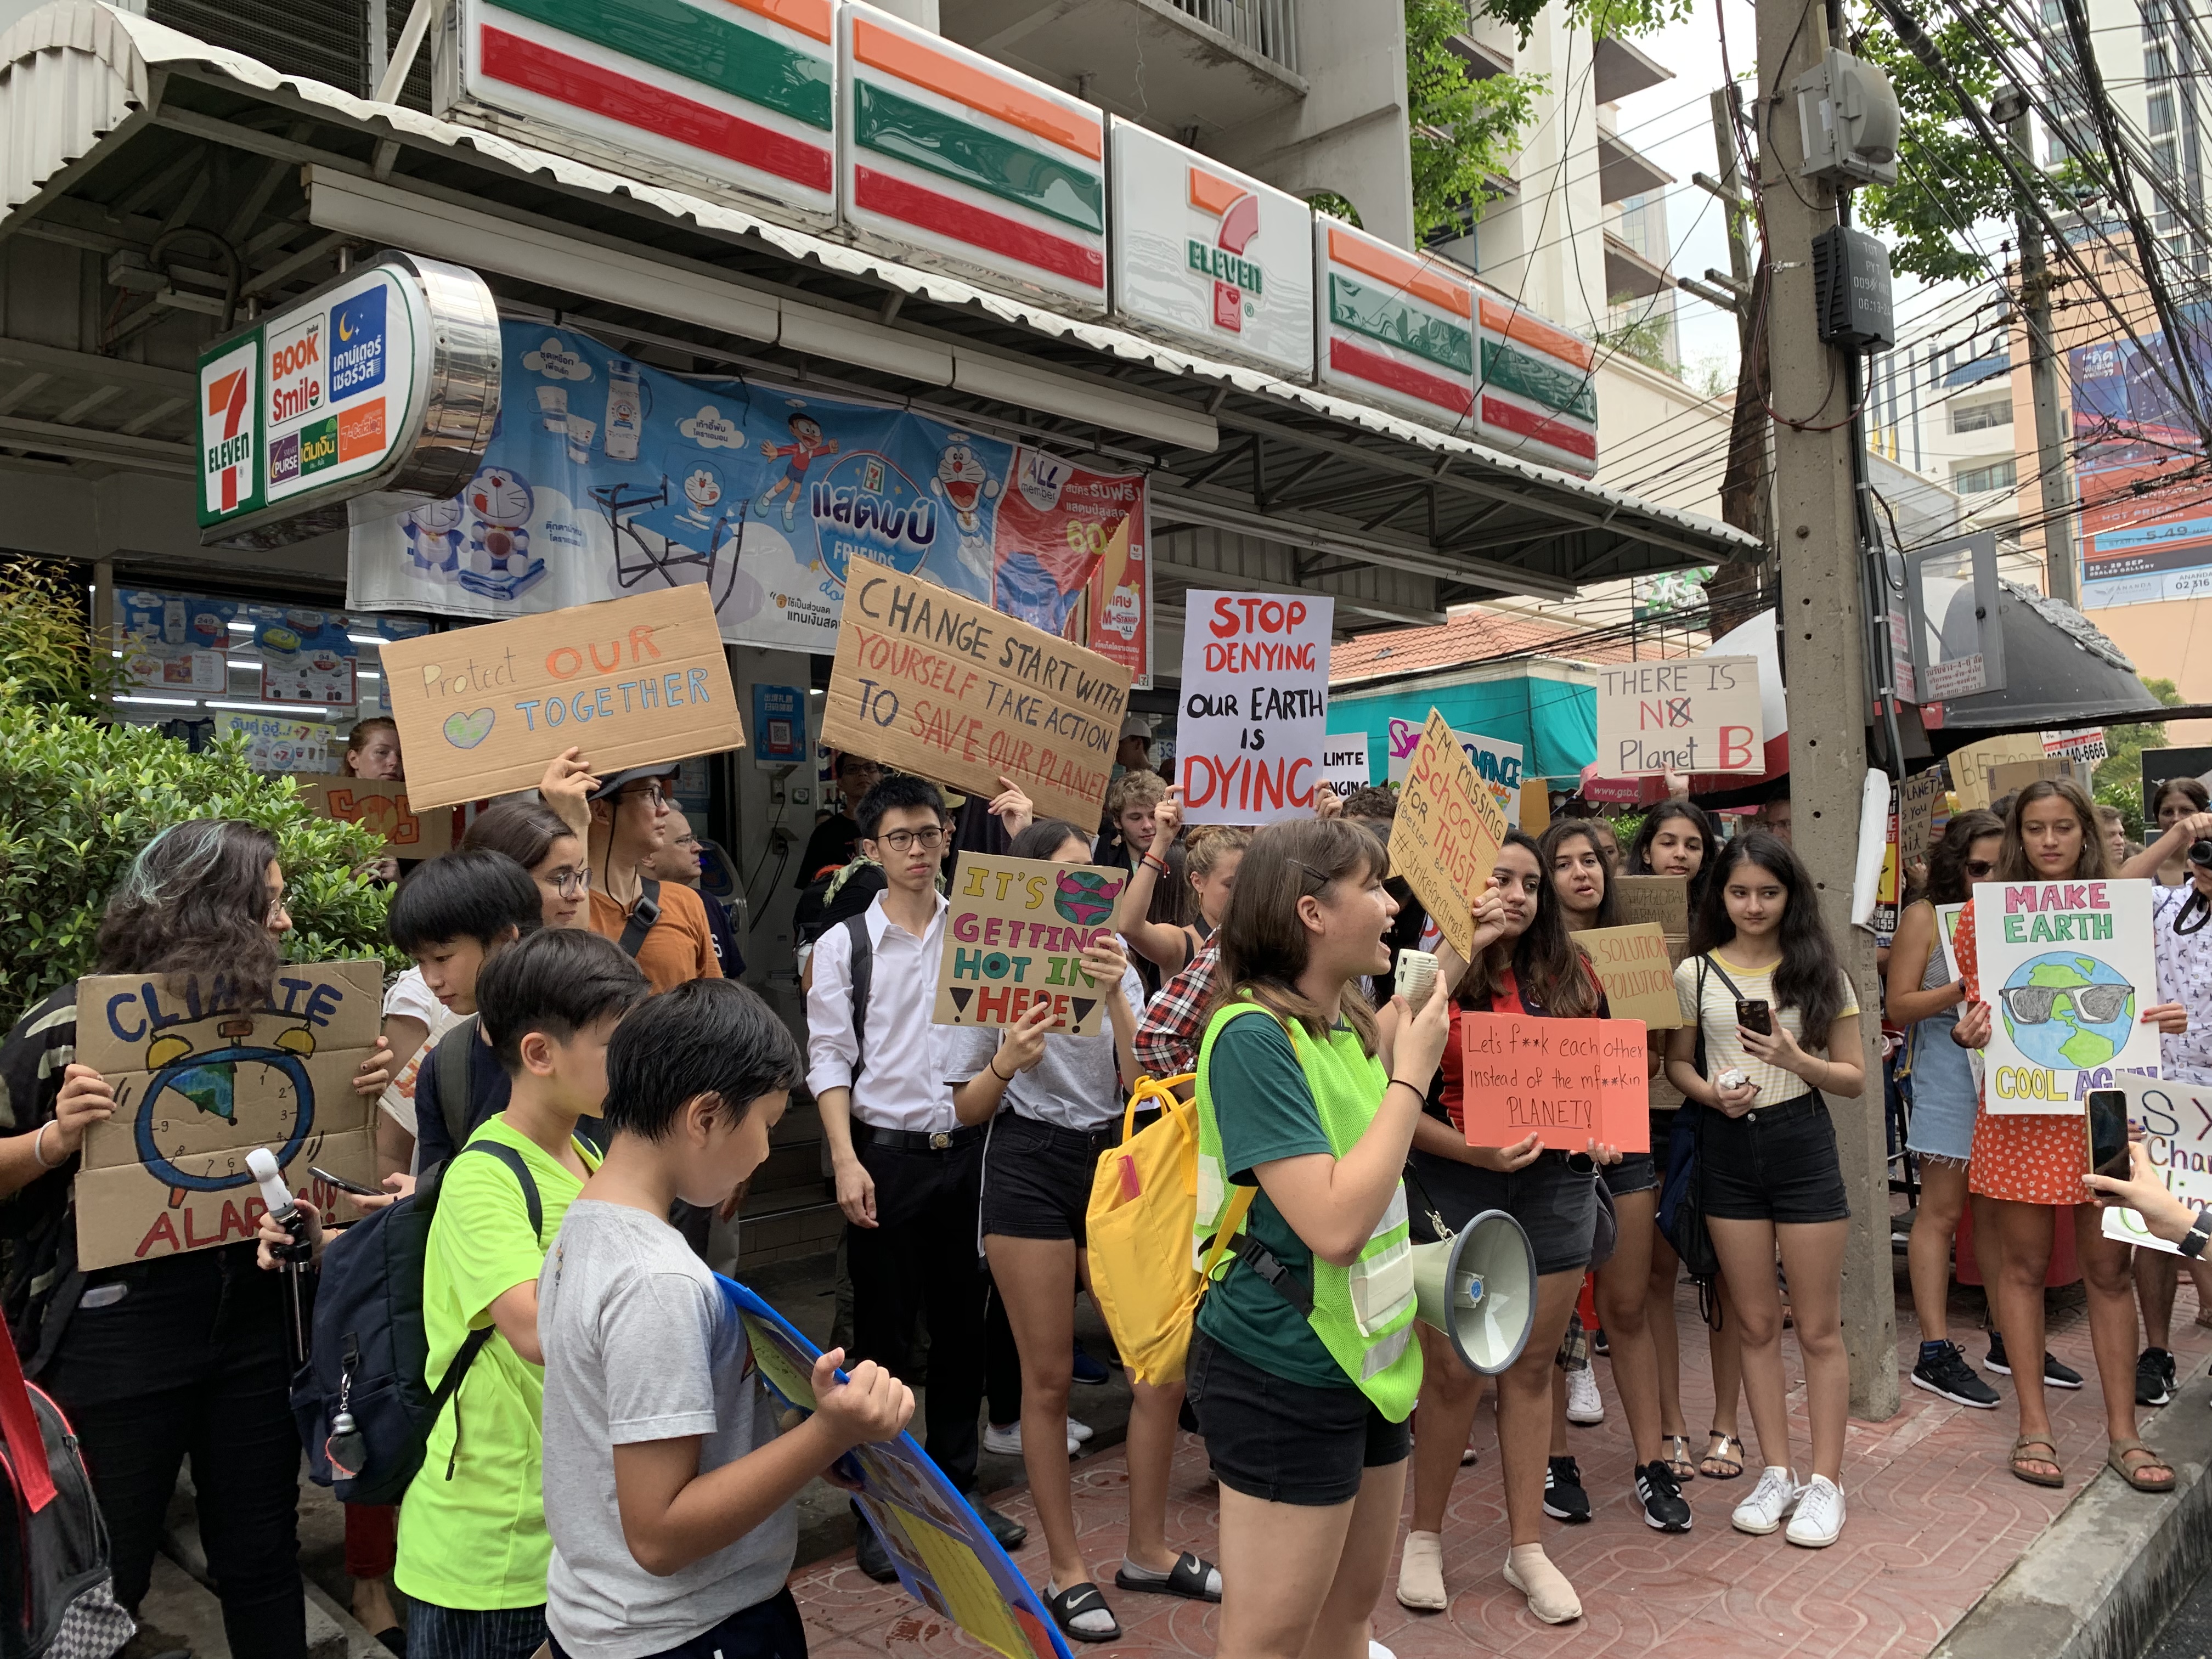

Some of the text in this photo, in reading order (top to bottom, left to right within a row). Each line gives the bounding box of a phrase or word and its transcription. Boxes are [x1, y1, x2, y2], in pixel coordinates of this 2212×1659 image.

[1863, 242, 1877, 256] TOT
[1866, 261, 1880, 275] PYT
[273, 332, 319, 381] BOOK
[273, 376, 319, 422] Smile
[275, 454, 298, 475] PURSE
[1023, 457, 1058, 489] ALL
[1021, 483, 1057, 501] member
[812, 483, 936, 545] แสตมป์
[1066, 520, 1108, 555] 60
[2176, 582, 2190, 590] 02
[1209, 597, 1307, 639] STOP
[422, 624, 661, 698] Protect OUR
[860, 578, 994, 661] CHANGE
[998, 637, 1077, 692] START
[1076, 671, 1125, 715] WITH
[1203, 641, 1316, 674] DENYING
[854, 626, 1113, 755] YOURSELF TAKE ACTION
[1600, 664, 1736, 697] THERE IS
[515, 668, 710, 731] TOGETHER
[1186, 687, 1324, 721] OUR EARTH
[858, 678, 1108, 805] TO SAVE OUR PLANET
[1240, 728, 1265, 751] IS
[1620, 725, 1754, 771] Planet B
[1324, 752, 1364, 766] LIMTE
[1426, 712, 1504, 841] I'M MISSING
[1183, 754, 1315, 812] DYING
[1594, 785, 1639, 798] www.gsb.c
[1906, 780, 1937, 802] LANET
[1405, 774, 1476, 896] FOR THIS!
[963, 866, 1047, 910] IT'S
[2005, 882, 2111, 913] MAKE
[953, 912, 1112, 953] GETTING
[2003, 913, 2113, 943] EARTH
[1599, 935, 1669, 964] SOLUTION
[953, 947, 1099, 989] HOT IN
[1468, 1024, 1502, 1054] Let's
[1559, 1036, 1599, 1058] each
[1603, 1037, 1644, 1059] other
[1470, 1064, 1517, 1090] instead
[1526, 1067, 1543, 1090] of
[1551, 1067, 1574, 1090] the
[1995, 1065, 2068, 1102] COOL
[1505, 1096, 1593, 1130] PLANET!
